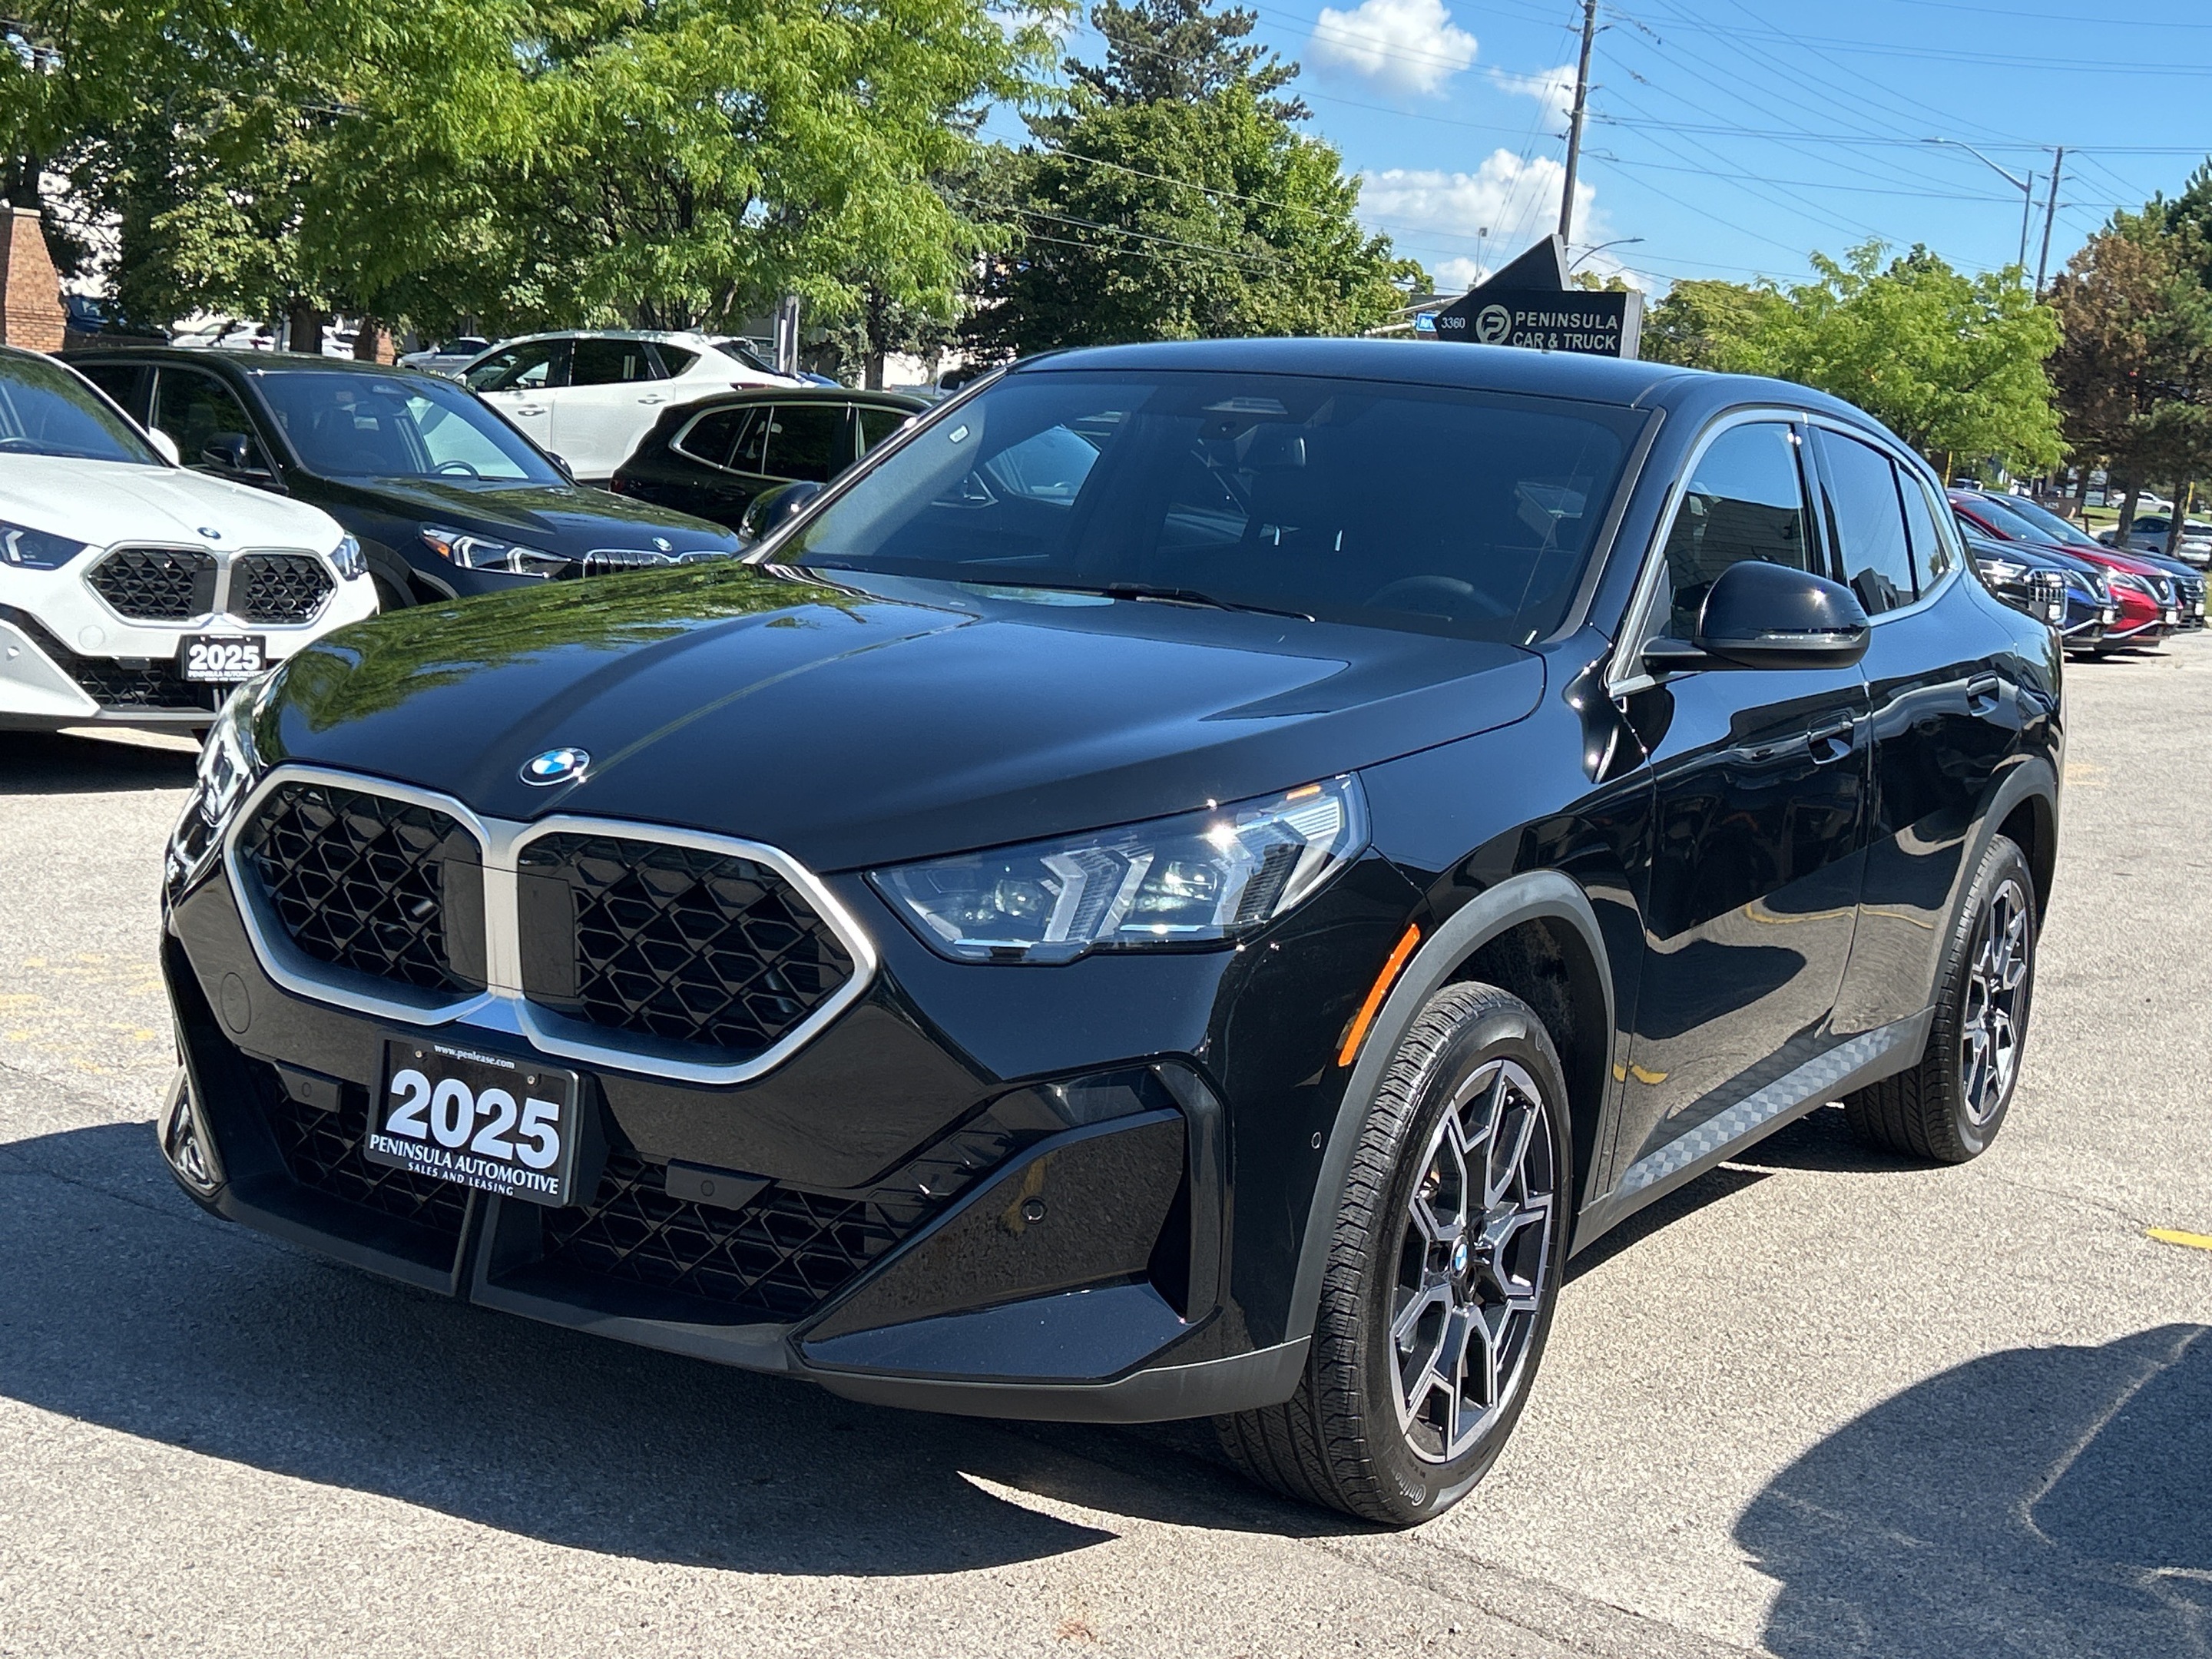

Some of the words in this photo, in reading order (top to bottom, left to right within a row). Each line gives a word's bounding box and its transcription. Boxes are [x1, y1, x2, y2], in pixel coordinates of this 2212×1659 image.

[1441, 317, 1465, 329] 3360
[1515, 311, 1618, 330] PENINSULA
[1512, 332, 1545, 349] CAR
[1548, 333, 1558, 349] &
[1563, 333, 1617, 350] TRUCK
[189, 644, 261, 671] 2025
[434, 1045, 515, 1069] www.penlease.com
[386, 1068, 561, 1169] 2025
[369, 1134, 452, 1169] PENINSULA
[454, 1157, 559, 1195] AUTOMOTIVE
[408, 1162, 439, 1177] SALES
[442, 1171, 465, 1184] AND
[469, 1177, 514, 1197] LEASING
